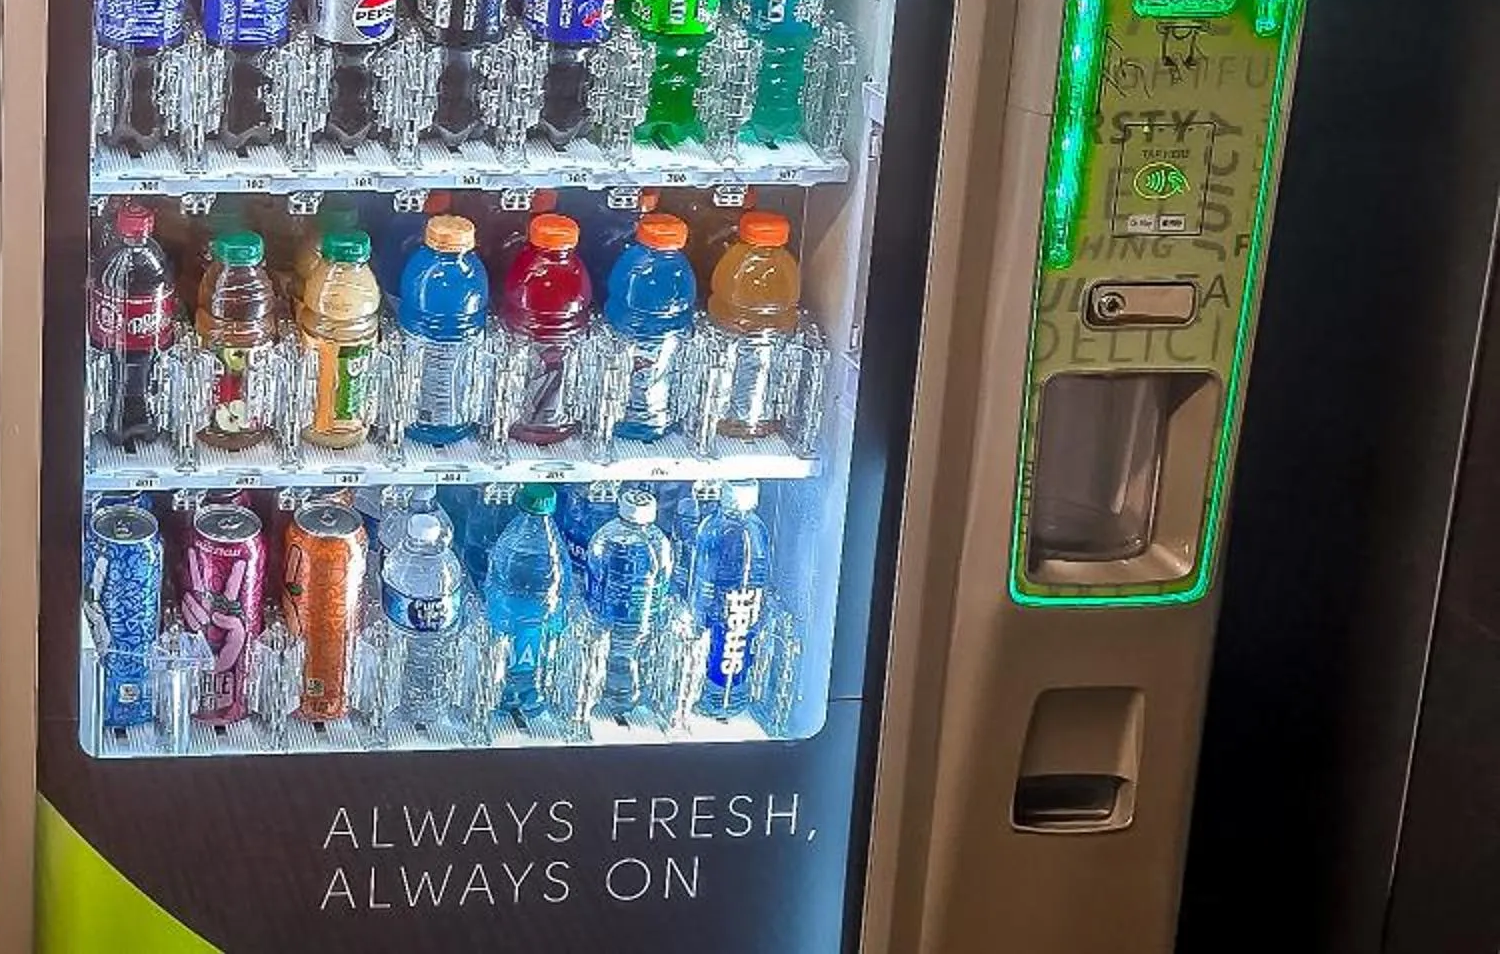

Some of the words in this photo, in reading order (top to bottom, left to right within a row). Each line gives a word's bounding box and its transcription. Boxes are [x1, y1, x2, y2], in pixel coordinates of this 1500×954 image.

[323, 801, 575, 848] ALWAYS
[612, 793, 817, 842] FRESH,
[321, 861, 572, 910] ALWAYS
[606, 856, 700, 902] ON
